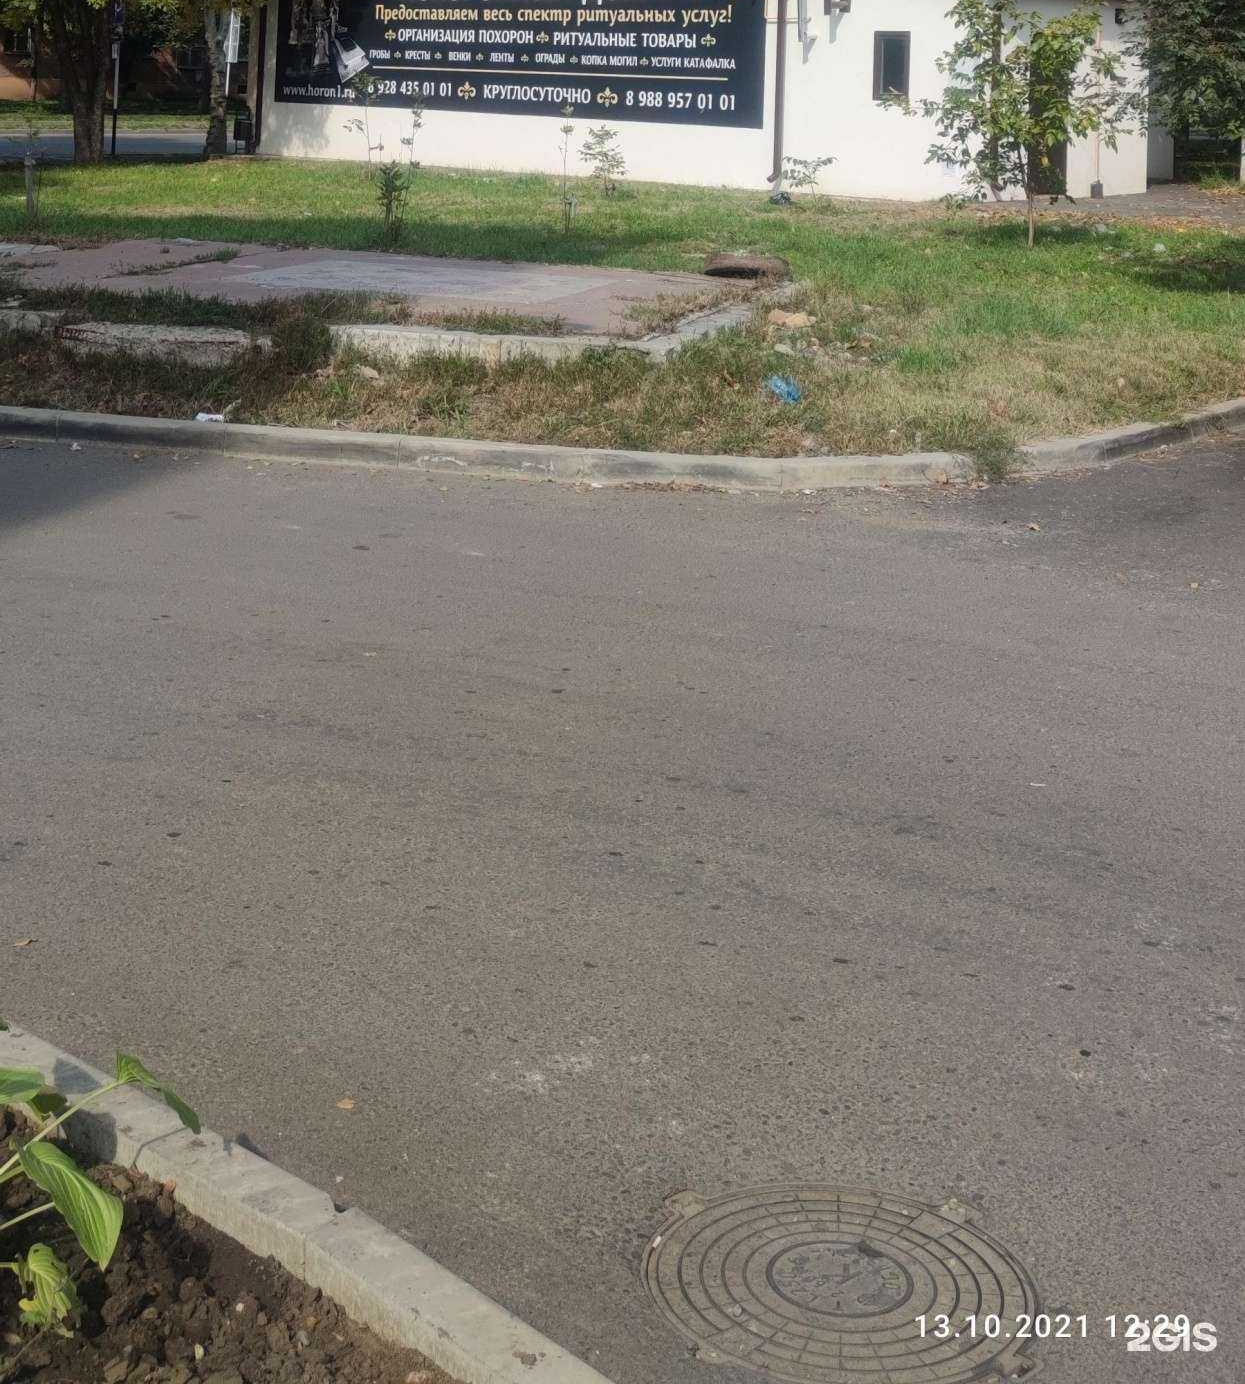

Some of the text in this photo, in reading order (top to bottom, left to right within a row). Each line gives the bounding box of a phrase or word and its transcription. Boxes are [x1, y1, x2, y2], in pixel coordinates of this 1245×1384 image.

[375, 4, 733, 28] Предоставляем весь спектр ритуальных услуг!
[397, 28, 697, 49] ОРГАНИЗАЦИЯ ПОХОРОН РИТУАЛЬНЫЕ ТОВАРЫ
[369, 49, 737, 70] ГРОБЫ КРЕСТЫ ВЕНКИ ЛЕНТЫ ОГРАДЫ КОПКА МОГИЛ УСЛУГИ КАТАФАЛКА
[282, 83, 356, 99] www.horon1.ru
[377, 80, 397, 95] 928
[399, 81, 419, 96] 435
[423, 82, 436, 97] 01
[439, 83, 452, 97] 01
[483, 85, 591, 104] КРУГЛОСУТОЧНО
[625, 90, 634, 107] 8
[638, 91, 663, 108] 988
[667, 92, 692, 109] 957
[696, 93, 713, 110] 01
[719, 94, 736, 111] 01
